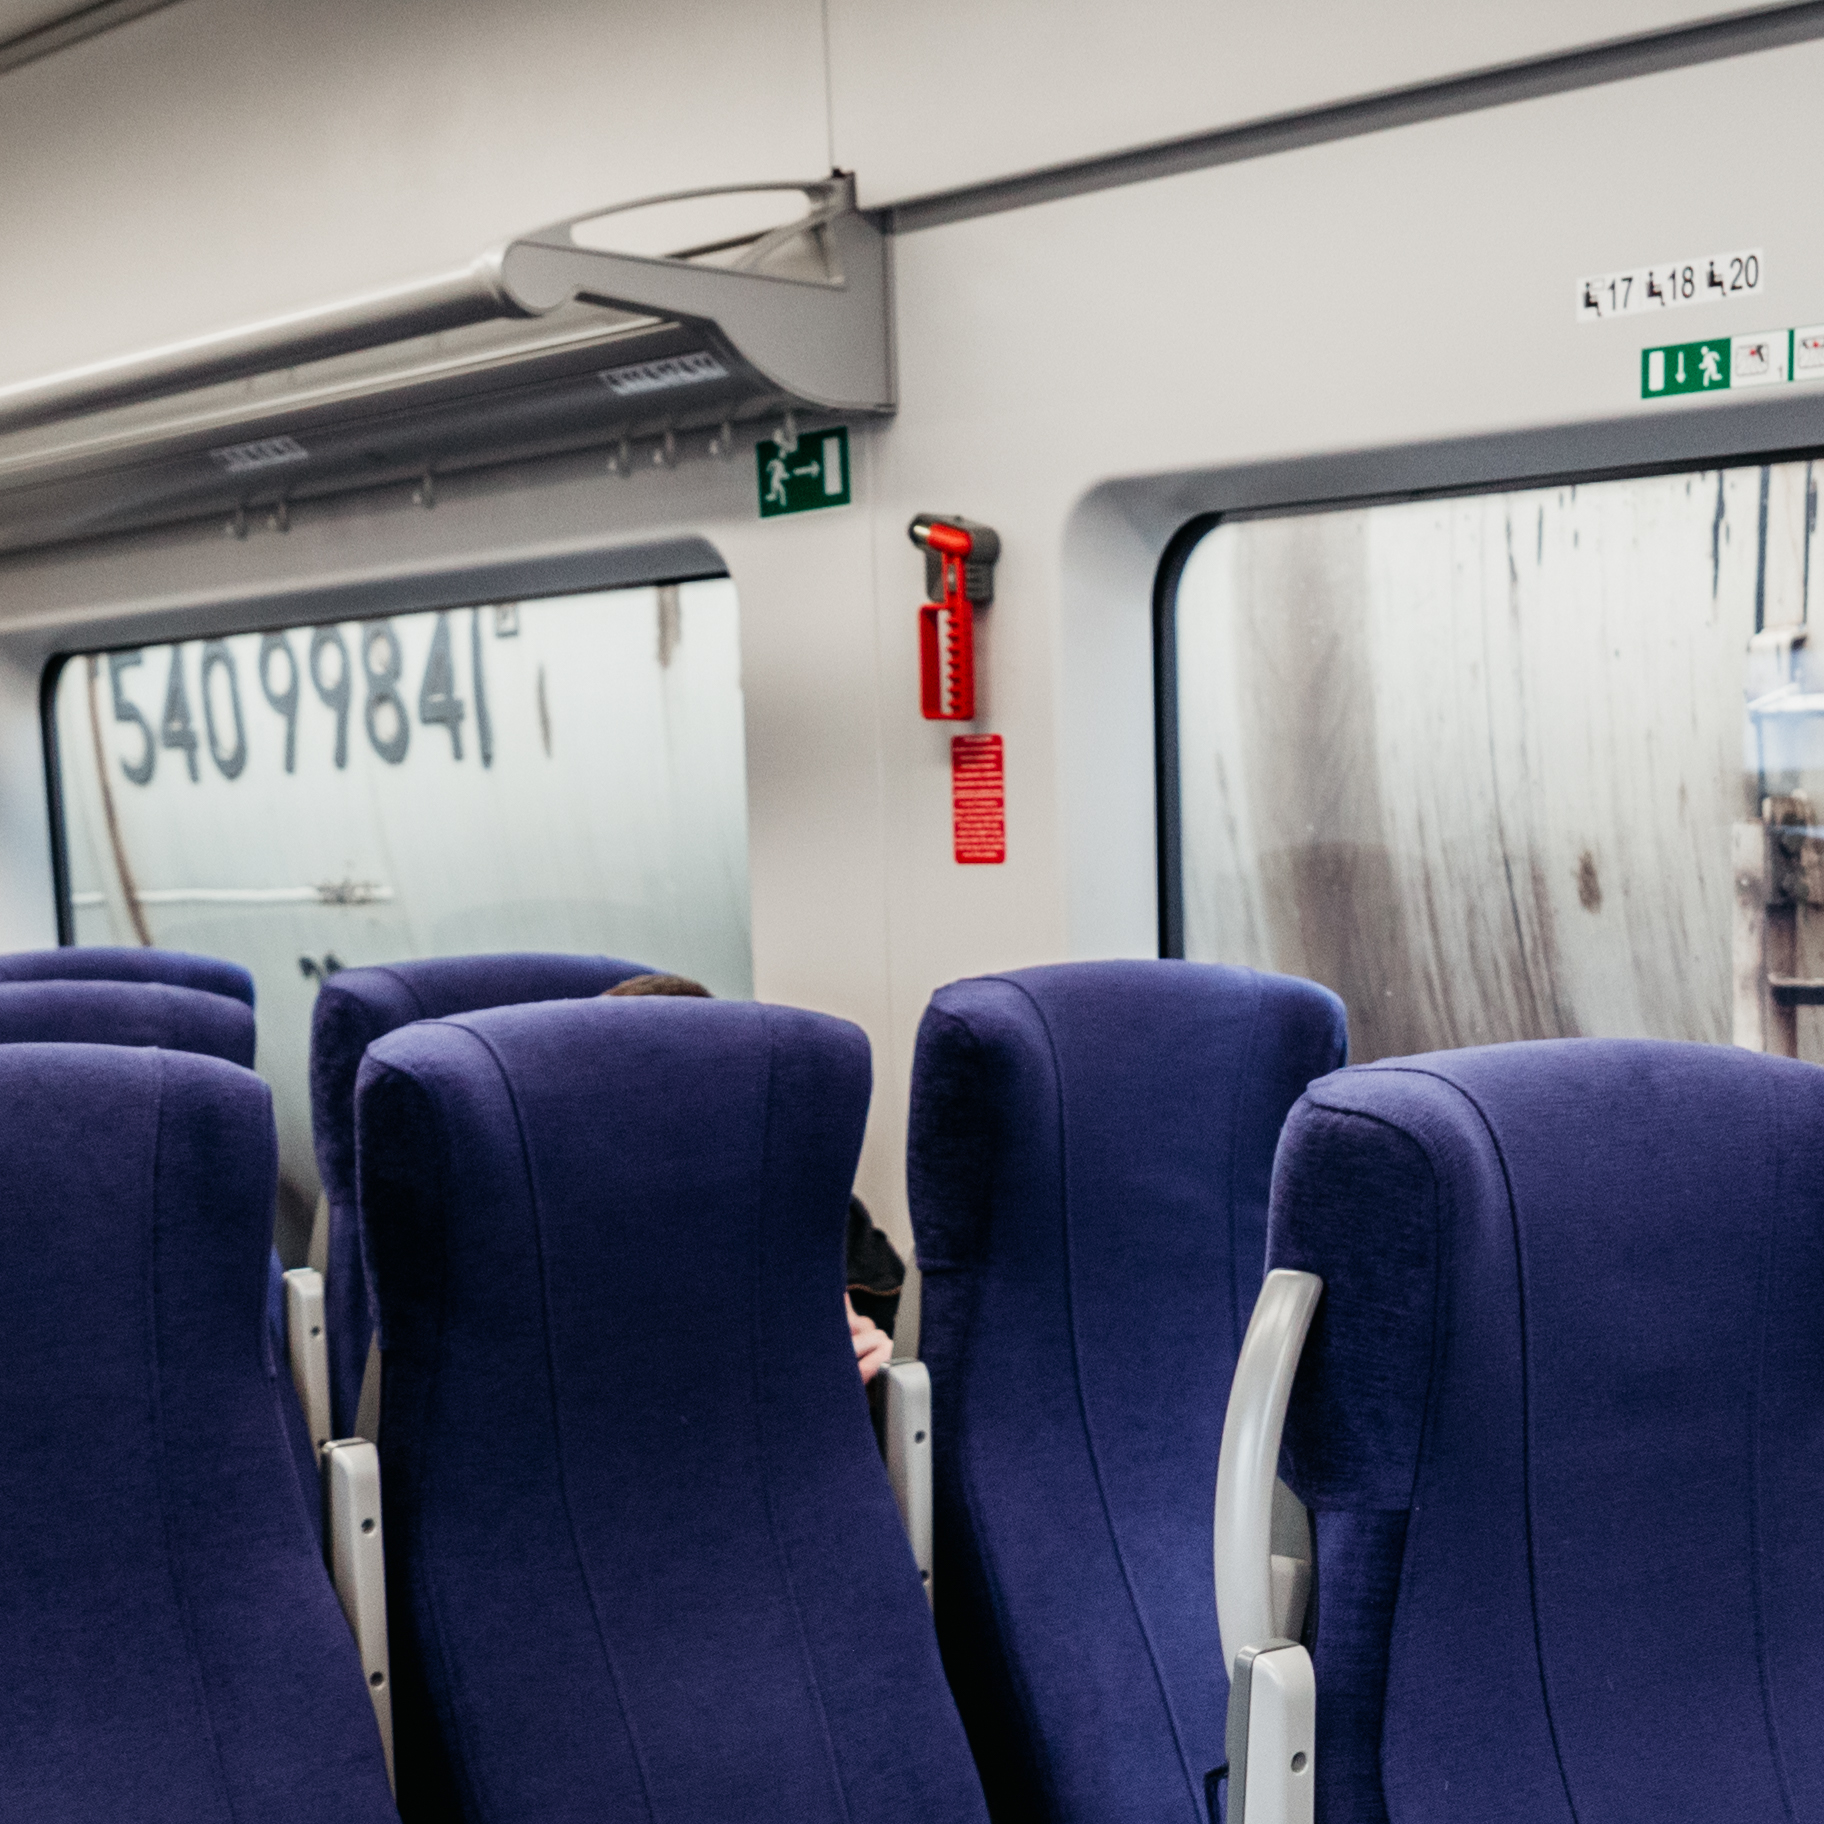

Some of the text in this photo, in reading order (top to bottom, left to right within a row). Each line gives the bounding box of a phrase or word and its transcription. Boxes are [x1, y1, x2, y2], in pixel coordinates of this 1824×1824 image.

[1607, 255, 1759, 311] 17 18 20
